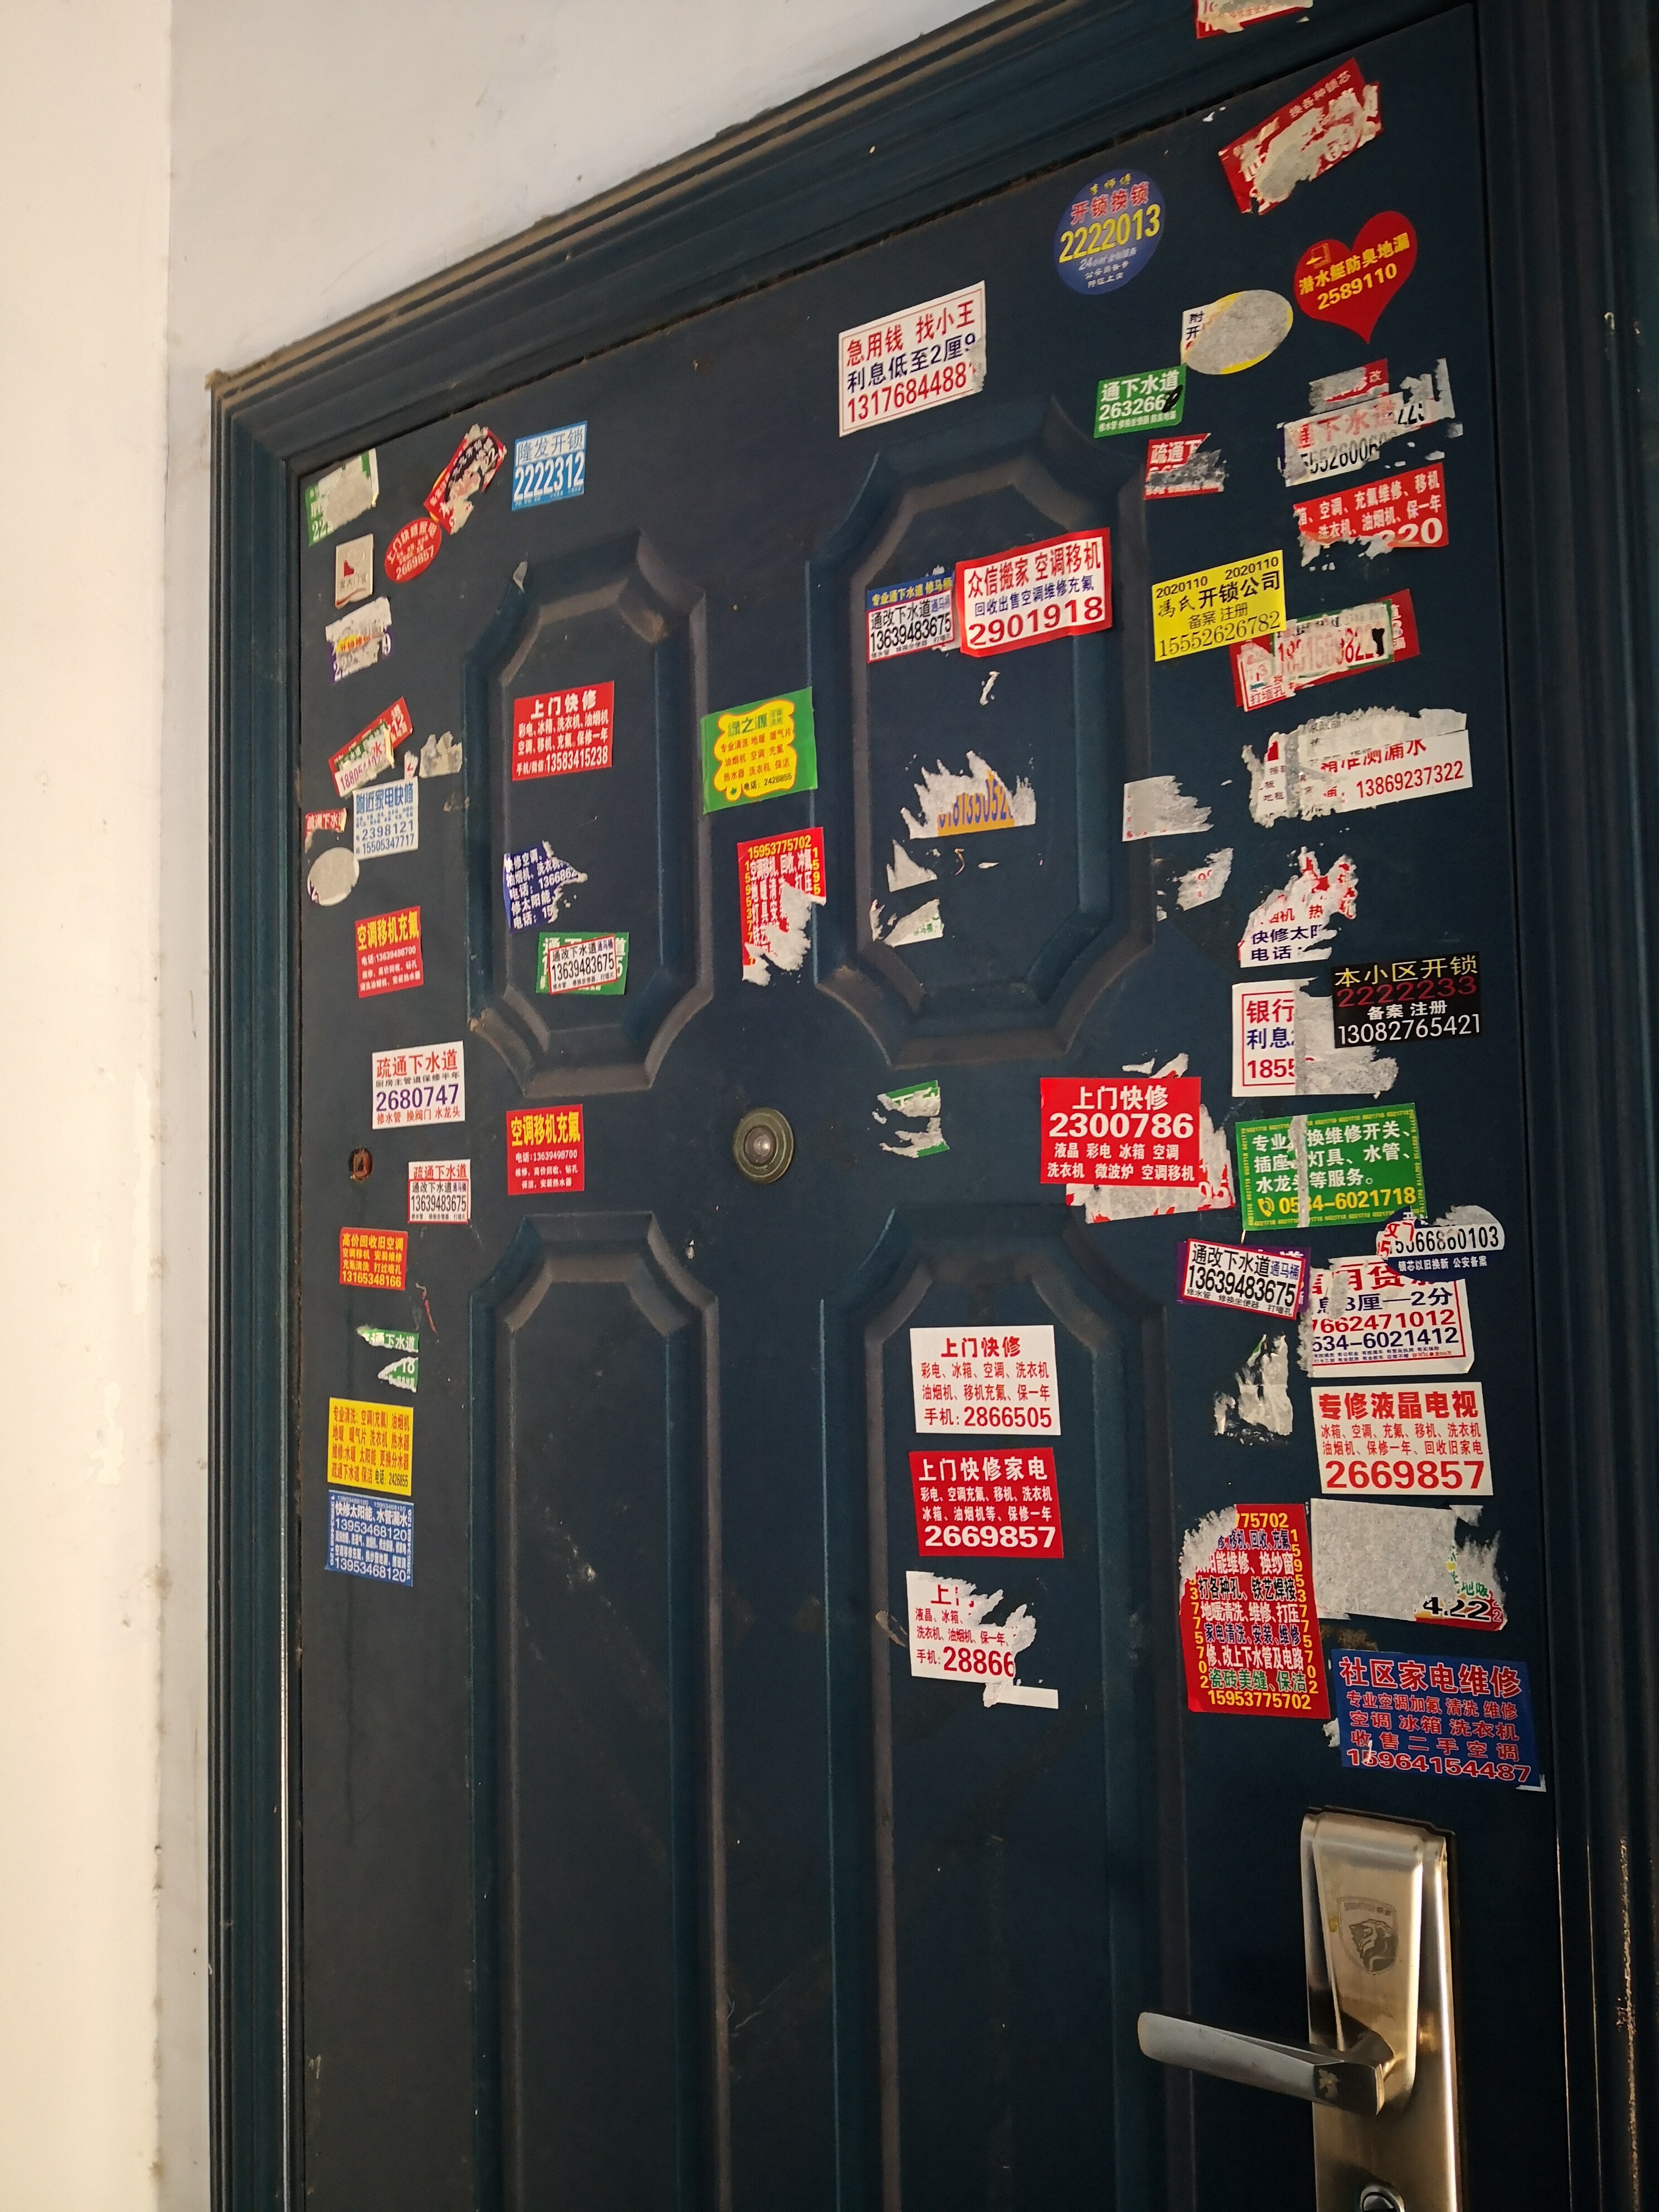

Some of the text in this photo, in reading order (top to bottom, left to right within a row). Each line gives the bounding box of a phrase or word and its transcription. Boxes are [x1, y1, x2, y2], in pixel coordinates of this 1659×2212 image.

[1070, 181, 1149, 226] 开锁换锁
[1059, 203, 1161, 264] 2222013
[1298, 232, 1411, 295] 潜水艇防臭地漏
[1317, 263, 1398, 311] 2589110
[847, 299, 975, 367] 急用钱 找小王
[1100, 369, 1180, 402] 通下水道
[1369, 370, 1382, 383] 改
[847, 362, 976, 423] 1317684488
[1099, 393, 1177, 421] 263266
[518, 428, 583, 466] 隆发开锁
[513, 452, 585, 502] 2222312
[968, 541, 1102, 598] 众信搬家 空调移机
[1156, 556, 1279, 599] 2020110 2020110
[974, 574, 1095, 617] 回收出售空调维修充氟
[1198, 570, 1281, 609] 开锁公司
[871, 599, 930, 630] 通改下水道
[969, 596, 1103, 646] 2901918
[1189, 602, 1249, 629] 备案 注册
[871, 612, 951, 652] 13639483675
[1160, 610, 1282, 658] 15552626782
[530, 688, 596, 720] 上门快修
[518, 709, 609, 739] 彩电、冰箱、洗衣机、油烟机
[1356, 761, 1464, 799] 13869237322
[356, 782, 414, 816] 附近家电快修
[362, 819, 414, 841] 2398121
[362, 833, 415, 855] 15505347717
[748, 835, 811, 859] 15953775702
[357, 910, 419, 951] 空调移机充氟
[552, 943, 596, 962] 通改下水道
[552, 952, 614, 982] 13639483675
[1335, 955, 1478, 988] 本小区开锁
[1337, 976, 1477, 1008] 2222233
[1367, 1000, 1448, 1021] 备案 注册
[1338, 1013, 1481, 1045] 13082765421
[377, 1049, 457, 1079] 疏通下水道
[376, 1083, 459, 1112] 2680747
[1072, 1085, 1168, 1110] 上门快修
[377, 1111, 401, 1125] 修水管
[435, 1104, 460, 1119] 水龙头
[511, 1110, 580, 1147] 空调移机充氟
[1049, 1113, 1194, 1138] 2300786
[1054, 1142, 1180, 1161] 液晶 彩电 冰箱 空调
[1047, 1162, 1195, 1182] 洗衣机 微波炉 空调移机
[412, 1181, 452, 1194] 通改下水道
[1279, 1187, 1416, 1215] 054-6021718
[411, 1194, 467, 1212] 13639483675
[342, 1232, 404, 1252] 高价回收旧空调
[1192, 1244, 1299, 1280] 通改下水道 通马桶
[342, 1270, 401, 1288] 13165348166
[1186, 1288, 1211, 1299] 修水管
[1189, 1265, 1296, 1307] 13639483675
[940, 1337, 1021, 1358] 上门快修
[920, 1361, 1049, 1379] 彩电、冰箱、空调、洗衣机
[922, 1383, 1051, 1401] 油烟机、移机充氟、保一年
[1318, 1390, 1479, 1421] 专修液晶电视
[1321, 1422, 1482, 1439] 冰箱、空调、充氟、移机、洗衣机
[1322, 1440, 1483, 1457] 油烟机、保修一年、回收旧家电
[919, 1456, 1048, 1482] 上门快修家电
[1325, 1460, 1485, 1490] 2669857
[922, 1506, 1052, 1522] 冰箱、油烟机等、保修一年
[336, 1518, 407, 1542] 13953468120
[924, 1525, 1056, 1549] 2669857
[335, 1556, 406, 1583] 13953468120
[1200, 1602, 1301, 1623] 地暖清洗、维修、打压
[1204, 1623, 1301, 1646] 家电清洗、安装、维修
[1206, 1645, 1304, 1671] 修、改上下水管及电路
[1209, 1668, 1307, 1693] 瓷砖美缝、保洁
[1338, 1656, 1522, 1699] 社区家电维修
[1208, 1690, 1312, 1710] 15953775702
[1346, 1690, 1519, 1721] 专业空调加氟 清洗 维修
[1350, 1710, 1520, 1742] 空调 冰箱 洗衣机
[1346, 1748, 1531, 1783] 15964154487
